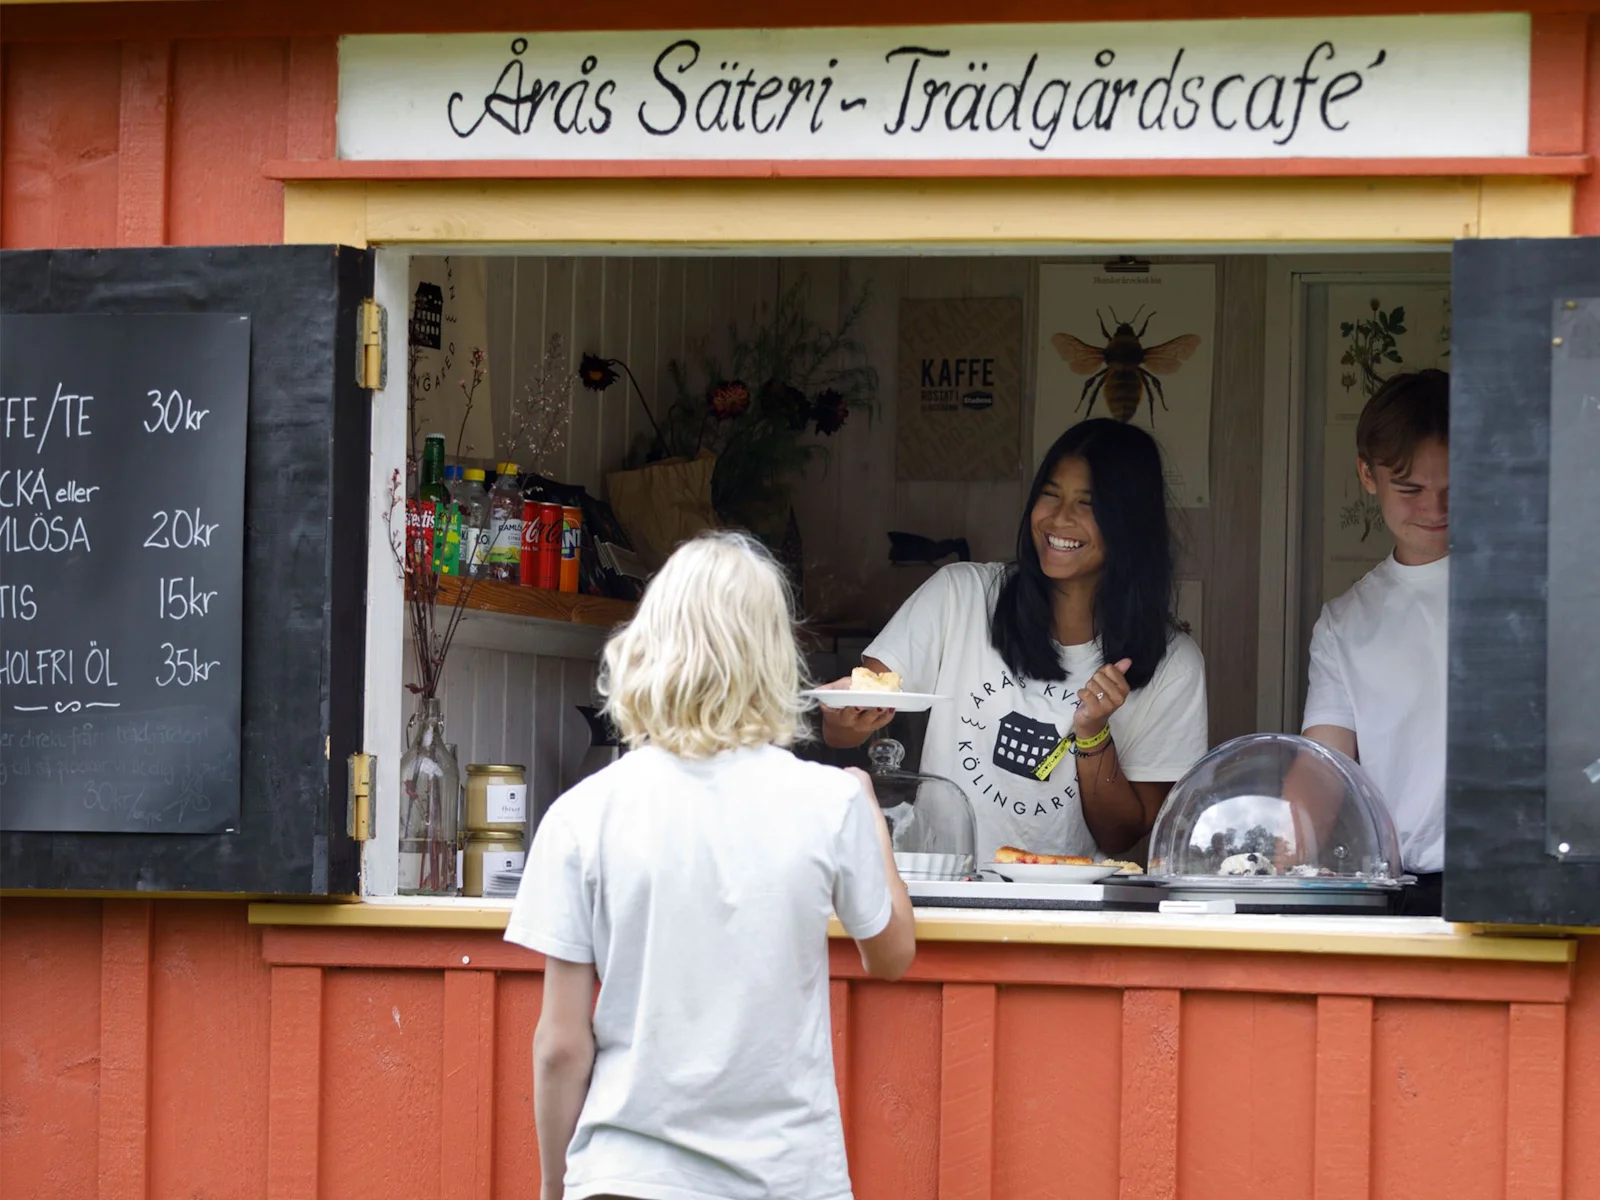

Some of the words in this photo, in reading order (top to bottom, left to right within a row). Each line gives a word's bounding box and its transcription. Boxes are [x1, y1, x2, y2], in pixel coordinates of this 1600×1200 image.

[448, 38, 616, 138] Årås
[921, 358, 995, 387] KAFFE
[0, 382, 95, 455] FE/TE
[143, 389, 211, 434] 30kr
[55, 479, 101, 503] eller
[143, 507, 220, 549] 20kr
[0, 584, 38, 621] TIS
[160, 576, 219, 620] 15kr
[0, 648, 74, 686] HOLFRI
[85, 640, 119, 687] ÖL
[155, 642, 221, 687] 35kr
[970, 670, 1026, 710] ÅRÅS
[958, 740, 1080, 816] KÖLINGARE
